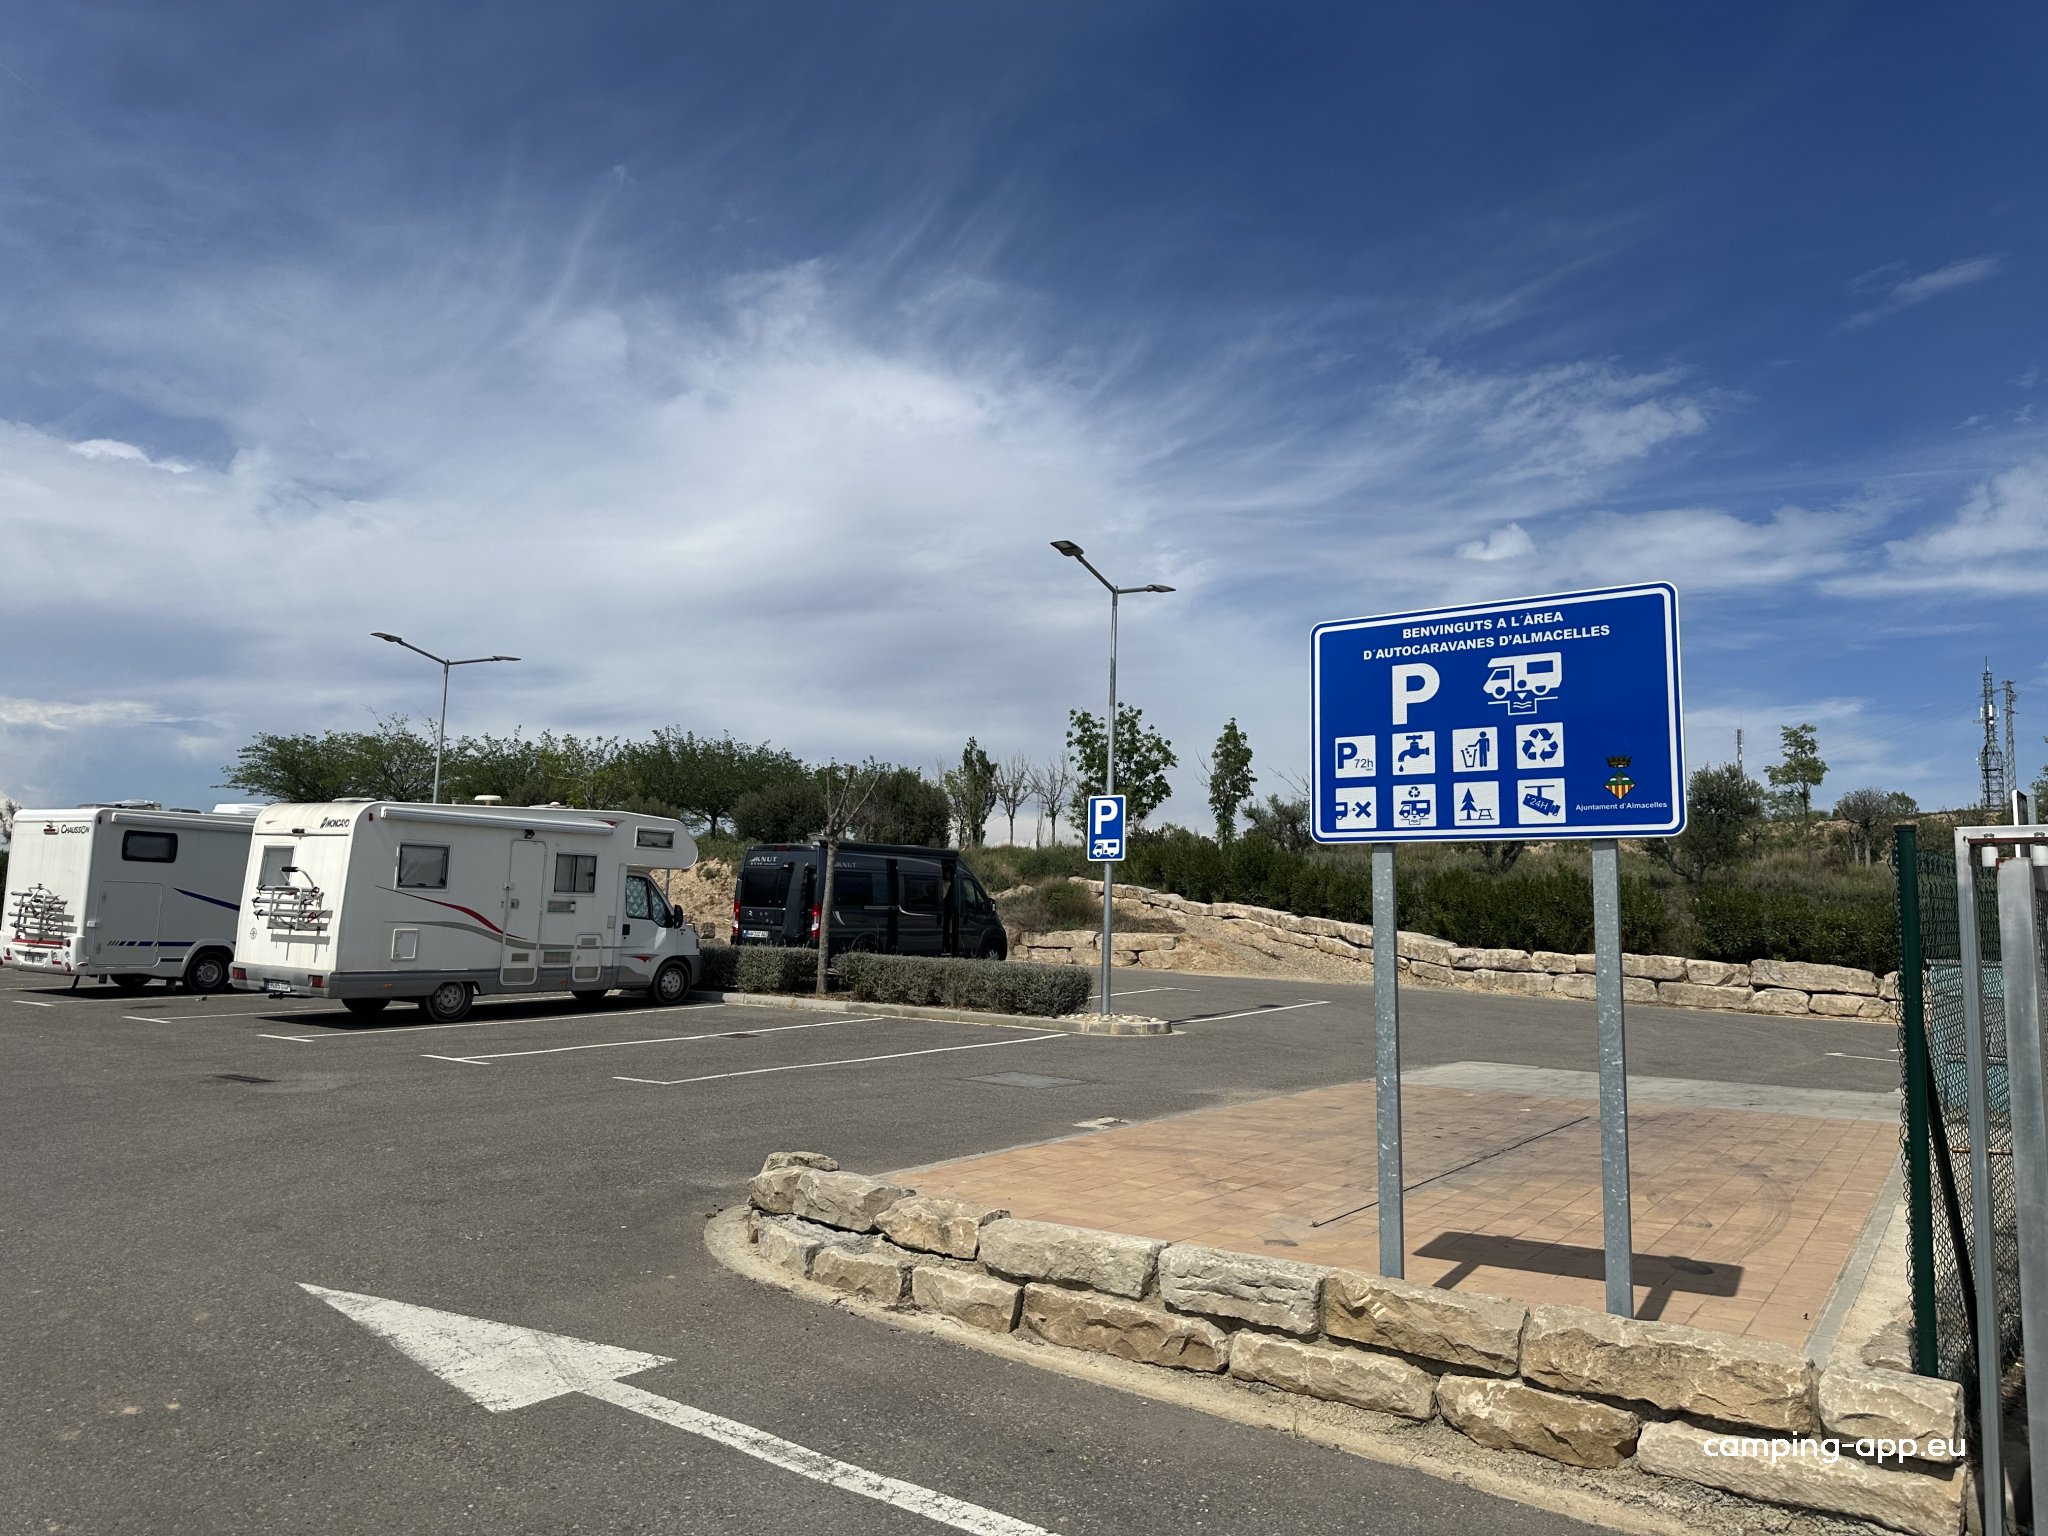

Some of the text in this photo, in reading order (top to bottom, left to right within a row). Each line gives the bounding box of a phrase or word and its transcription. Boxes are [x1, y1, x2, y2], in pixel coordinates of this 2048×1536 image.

[1402, 619, 1493, 639] BENVINGUTS
[1496, 617, 1507, 629] A
[1391, 662, 1440, 725] P
[1337, 742, 1358, 769] P
[1354, 758, 1374, 768] 72h
[1530, 797, 1549, 810] 24H
[1575, 804, 1618, 812] Ajuntament
[1094, 799, 1119, 835] P
